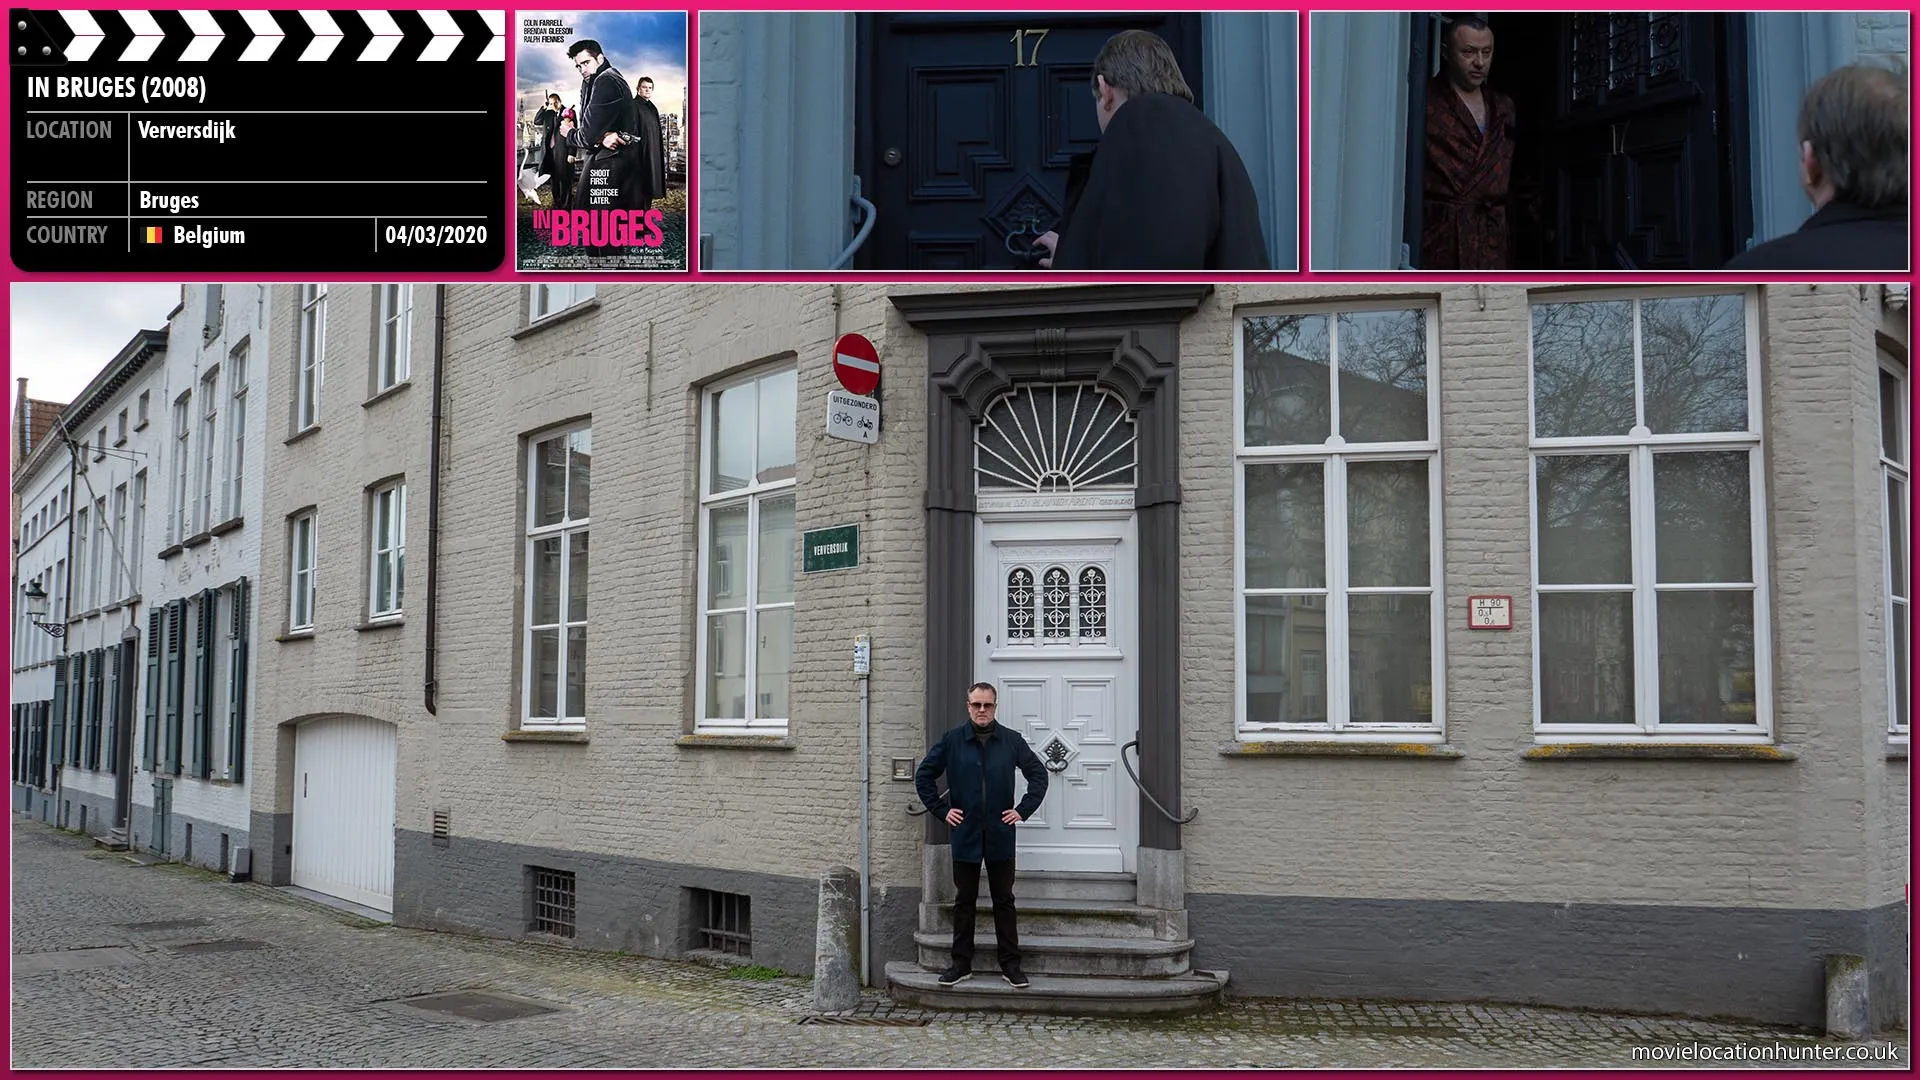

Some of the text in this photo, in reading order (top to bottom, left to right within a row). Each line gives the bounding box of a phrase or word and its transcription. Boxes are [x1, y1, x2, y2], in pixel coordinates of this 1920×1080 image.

[524, 19, 563, 27] COLIN FARRELL
[524, 27, 573, 35] BRENDAN GLEESON
[524, 35, 565, 43] RALPH FIENNES
[1010, 28, 1050, 66] 17
[590, 169, 610, 177] SHOOT
[590, 177, 609, 185] FIRST.
[590, 188, 619, 197] SIGHTSEE
[590, 196, 611, 205] LATER.
[533, 209, 664, 247] IN BRUGES
[832, 395, 878, 411] UITGEZONDERD
